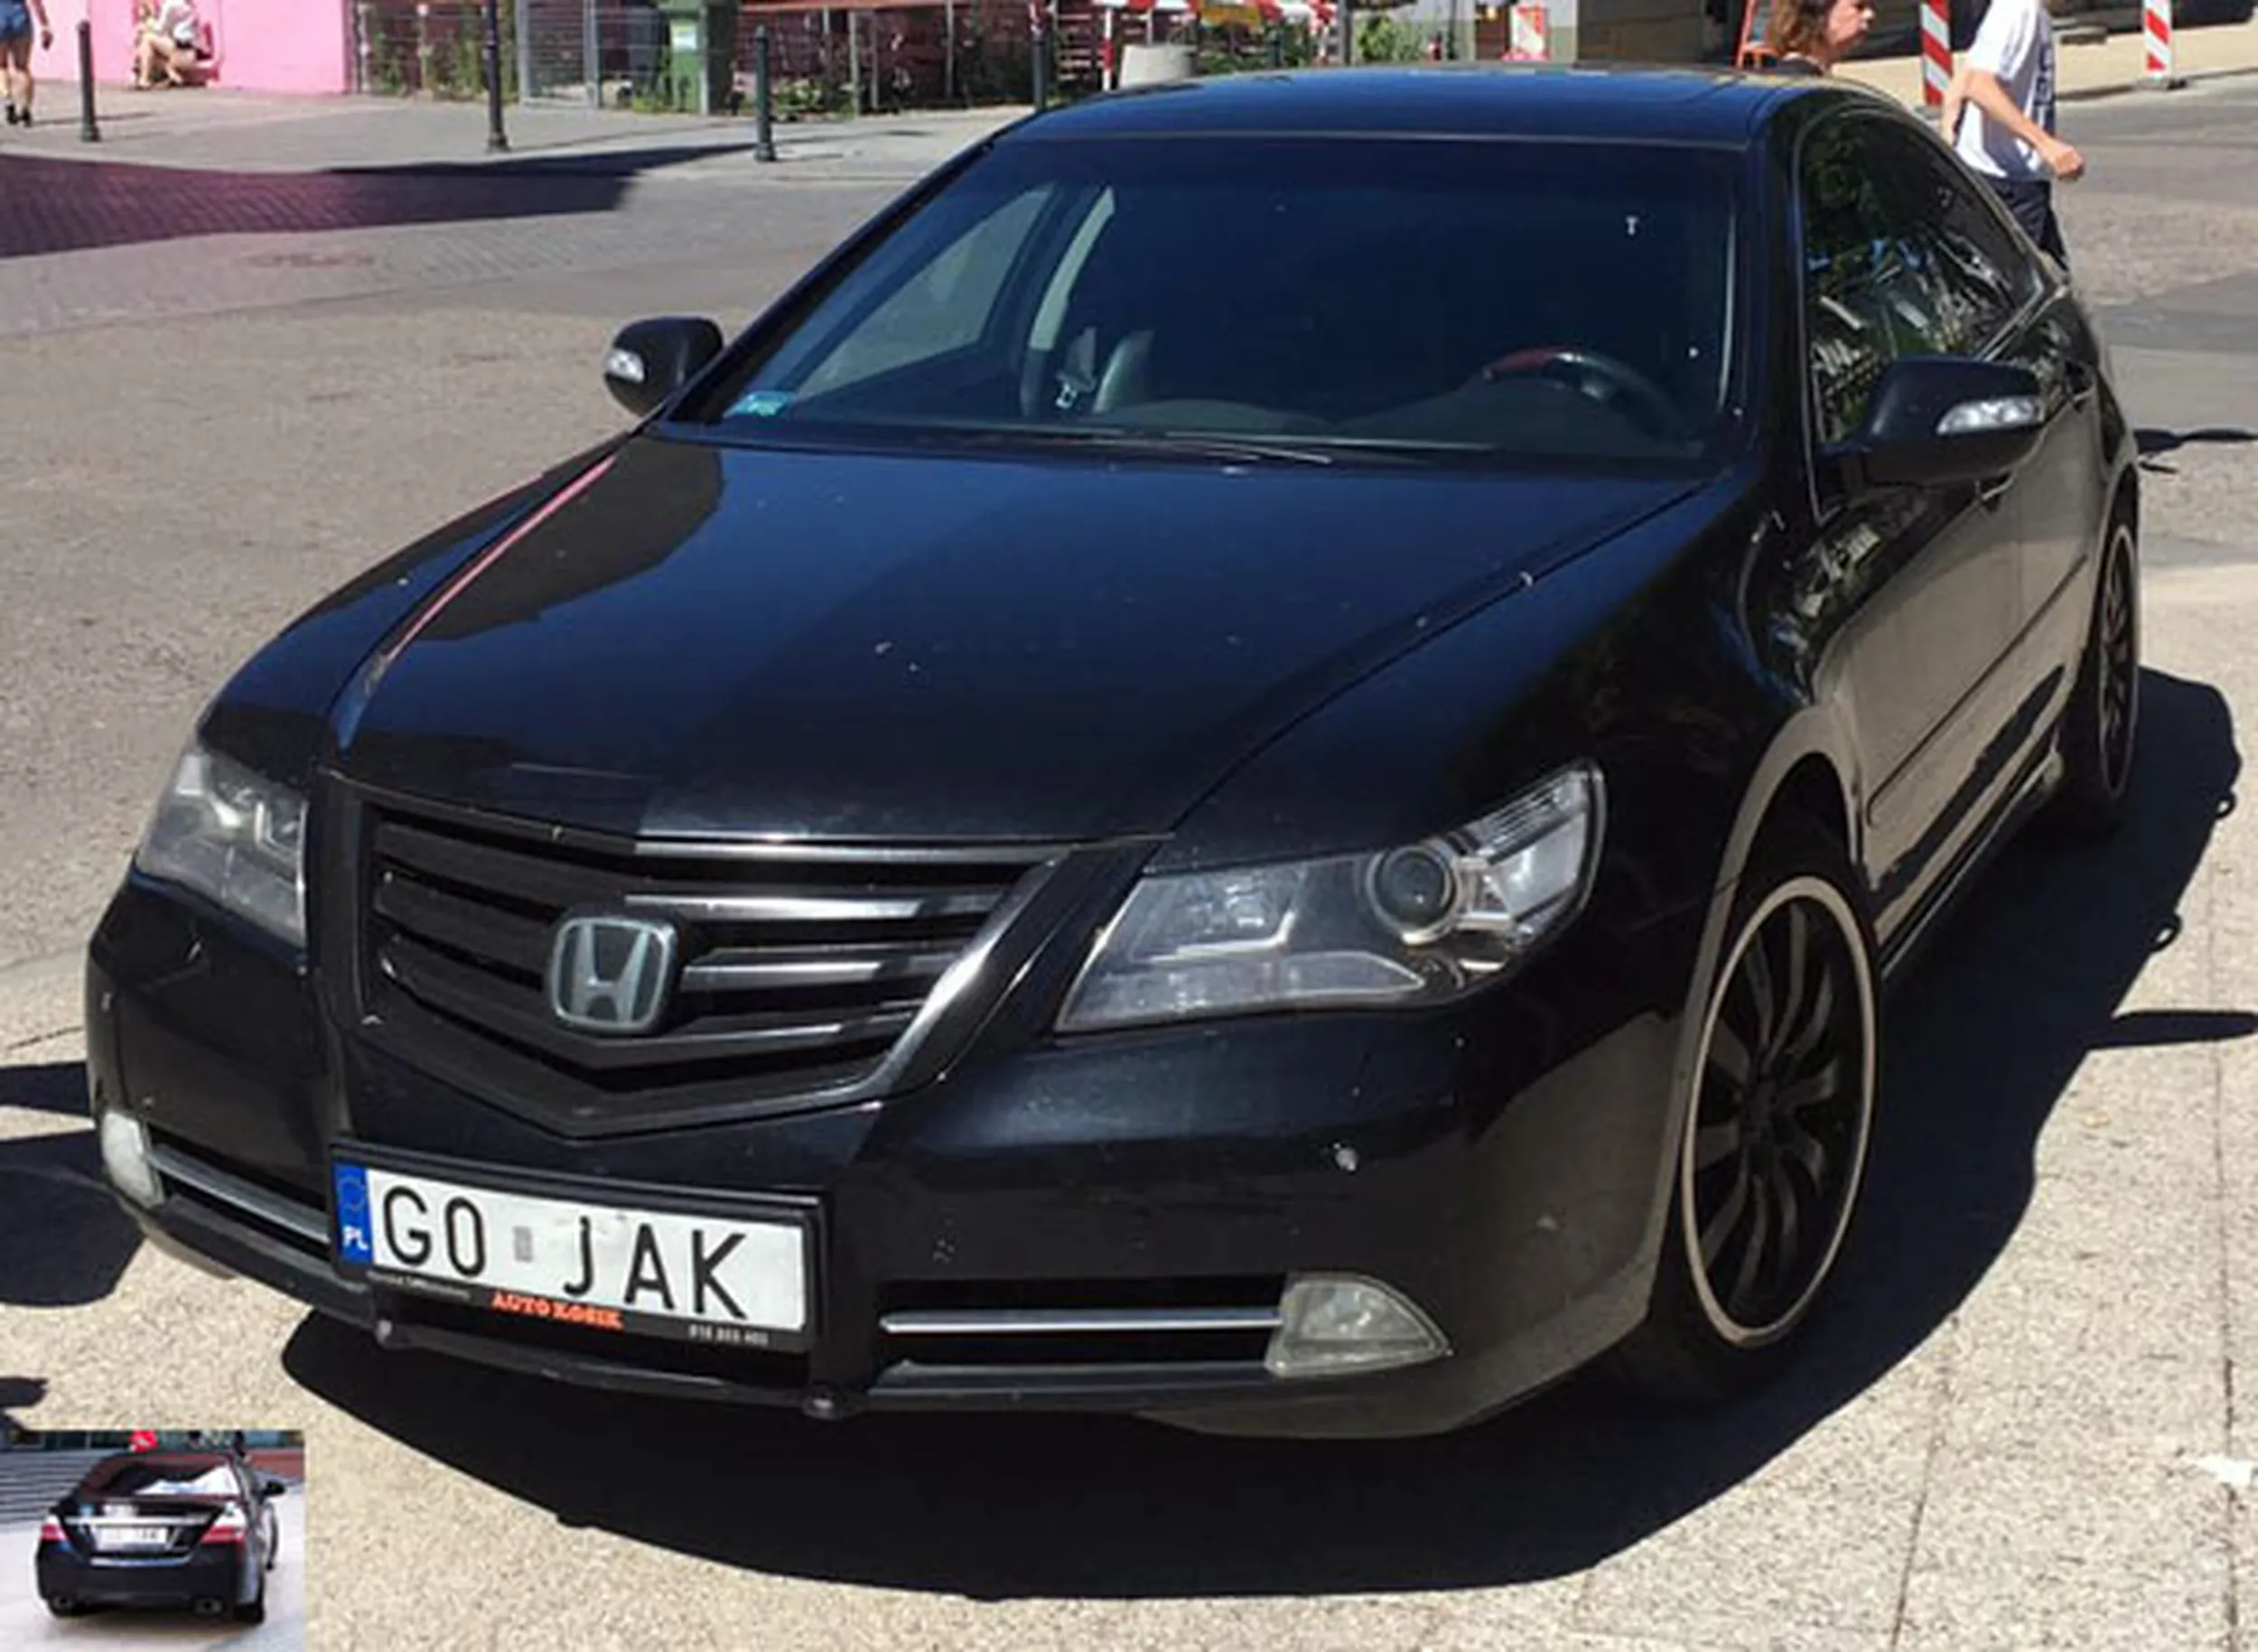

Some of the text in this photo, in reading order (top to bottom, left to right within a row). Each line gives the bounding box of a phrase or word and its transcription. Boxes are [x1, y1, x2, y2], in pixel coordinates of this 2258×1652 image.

[342, 1224, 369, 1250] PL
[563, 1215, 748, 1320] JAK
[492, 1292, 550, 1318] AUTO
